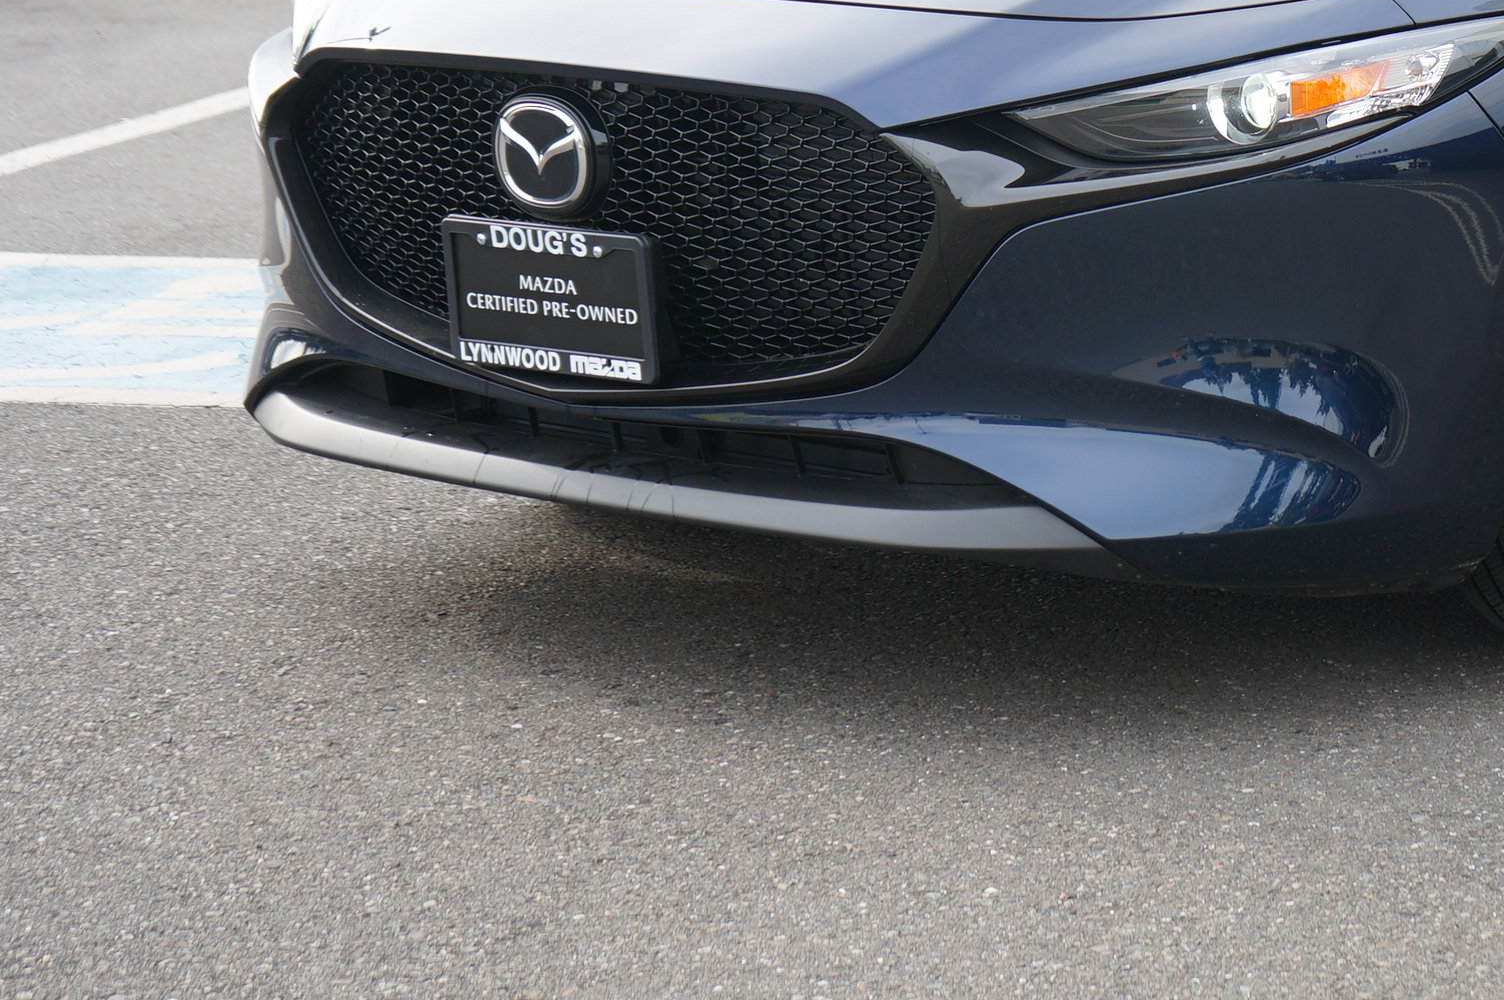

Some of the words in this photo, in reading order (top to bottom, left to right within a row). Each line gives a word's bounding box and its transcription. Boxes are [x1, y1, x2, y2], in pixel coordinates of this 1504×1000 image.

[489, 224, 588, 257] DOUG'S
[519, 274, 578, 296] MAZDA
[466, 292, 538, 315] CERTIFIED
[543, 301, 638, 325] PRE-OWNED
[460, 341, 561, 371] LYNNWOOD
